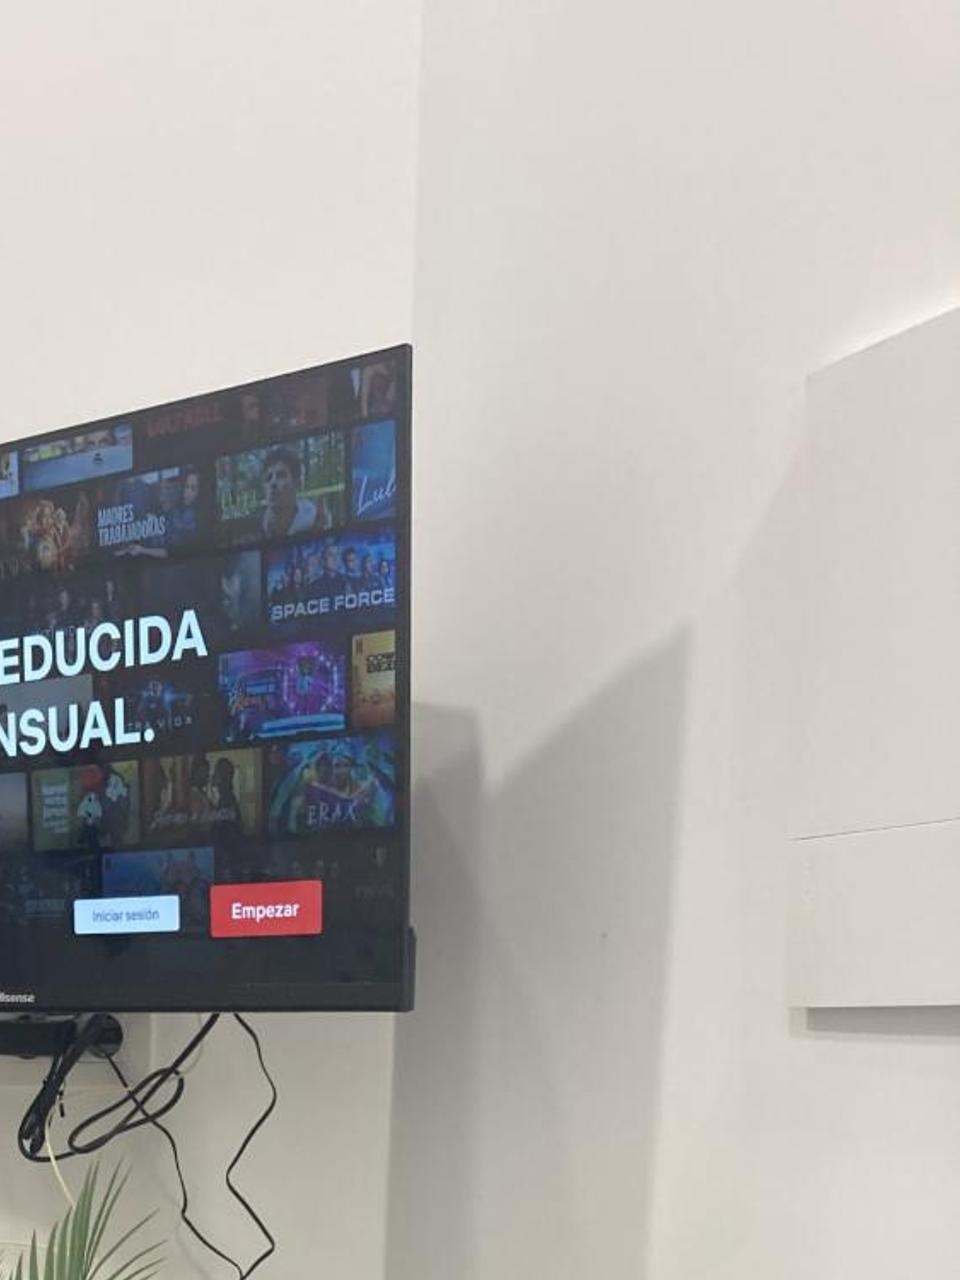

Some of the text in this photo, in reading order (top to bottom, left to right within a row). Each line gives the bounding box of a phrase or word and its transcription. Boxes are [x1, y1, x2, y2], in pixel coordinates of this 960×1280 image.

[270, 587, 396, 621] SPACE FORCE
[92, 906, 160, 923] Iniciar sesión
[231, 901, 301, 923] Empezar
